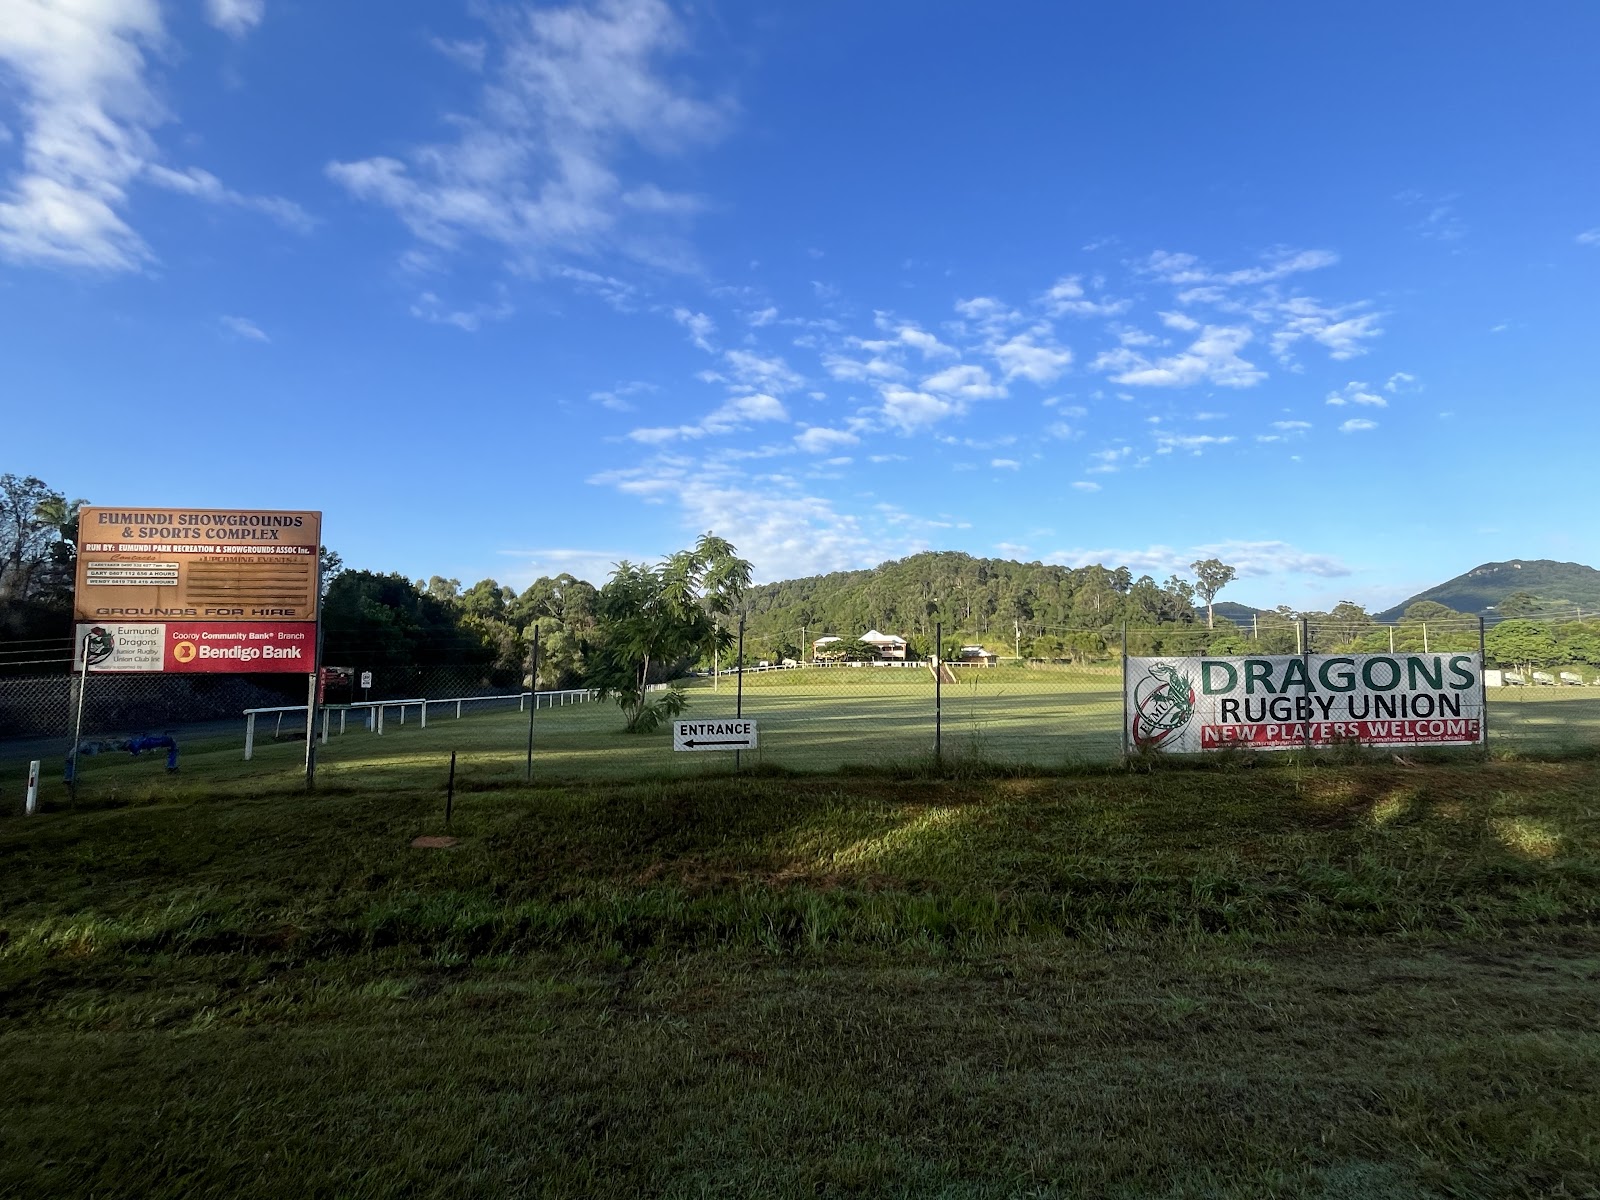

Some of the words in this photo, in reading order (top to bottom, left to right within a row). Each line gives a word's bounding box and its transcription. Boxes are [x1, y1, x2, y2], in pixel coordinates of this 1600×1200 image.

[98, 512, 173, 525] EUMUNDI
[178, 514, 303, 527] SHOWGROUNDS
[122, 527, 134, 538] &
[138, 527, 201, 539] SPORTS
[205, 528, 279, 540] COMPLEX
[118, 544, 151, 552] EUMUNDI
[152, 545, 172, 553] PARK
[173, 545, 214, 553] RECREATION
[222, 546, 275, 554] SHOWGROUNDS
[96, 608, 197, 616] GROUNDS
[204, 608, 244, 616] FOR
[117, 626, 160, 635] Eumundi
[172, 632, 200, 640] Cooroy
[202, 632, 247, 640] Community
[119, 638, 157, 646] Dragons
[200, 646, 260, 661] Bendigo
[262, 646, 302, 659] Bank
[1202, 656, 1475, 695] DRAGONS
[1221, 695, 1336, 723] RUGBY
[1348, 694, 1461, 720] UNION
[680, 724, 751, 736] ENTRANCE
[1204, 726, 1257, 742] NEW
[1266, 722, 1360, 741] PLAYERS
[1366, 720, 1478, 736] WELCOME
